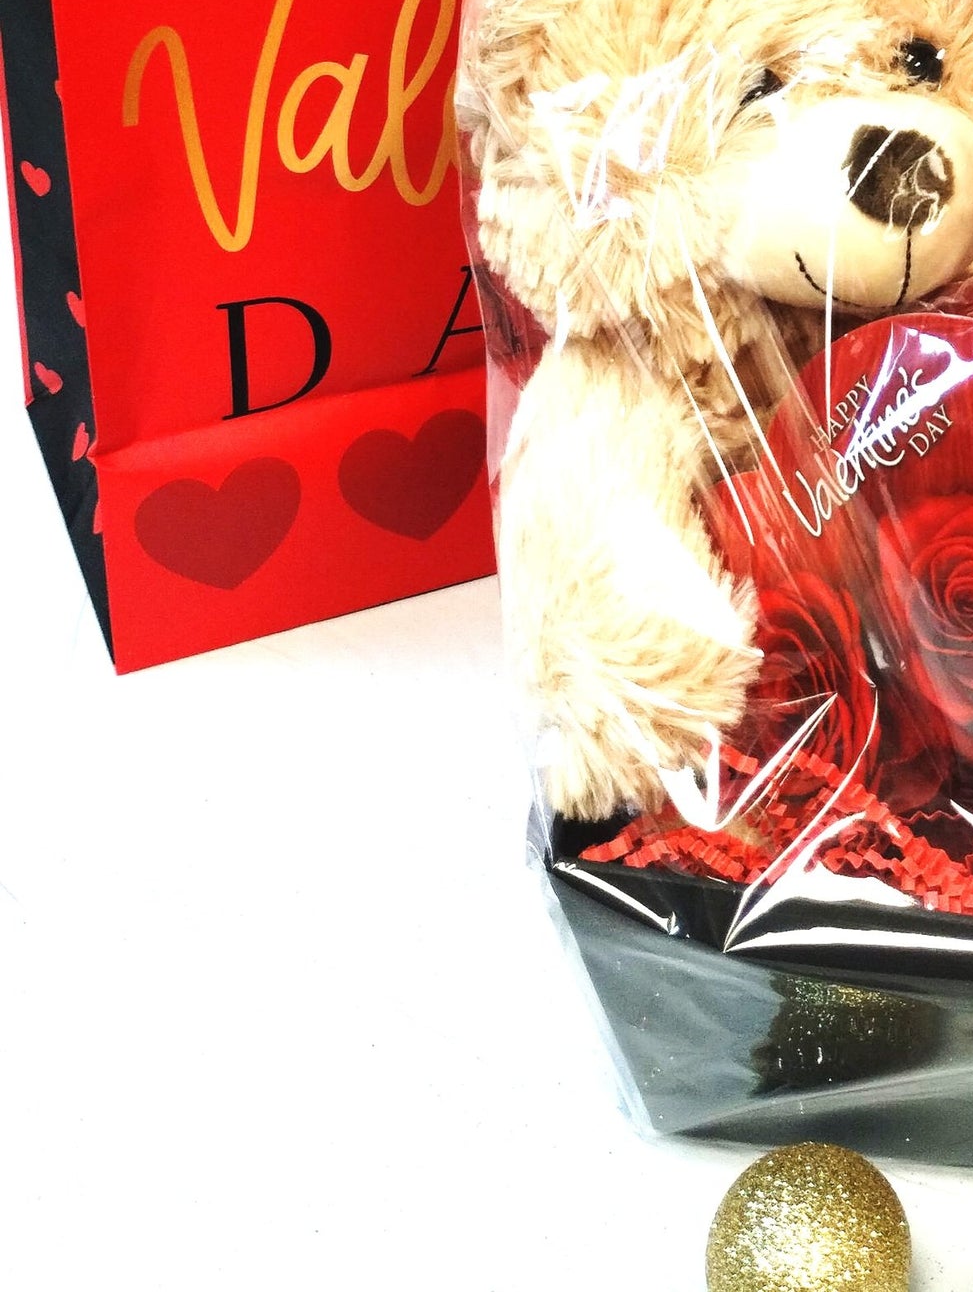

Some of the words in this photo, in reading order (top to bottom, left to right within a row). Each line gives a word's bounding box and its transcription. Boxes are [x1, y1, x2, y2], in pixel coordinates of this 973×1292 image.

[216, 265, 519, 421] DA
[810, 374, 873, 452] HAPPY
[908, 404, 953, 457] DAY
